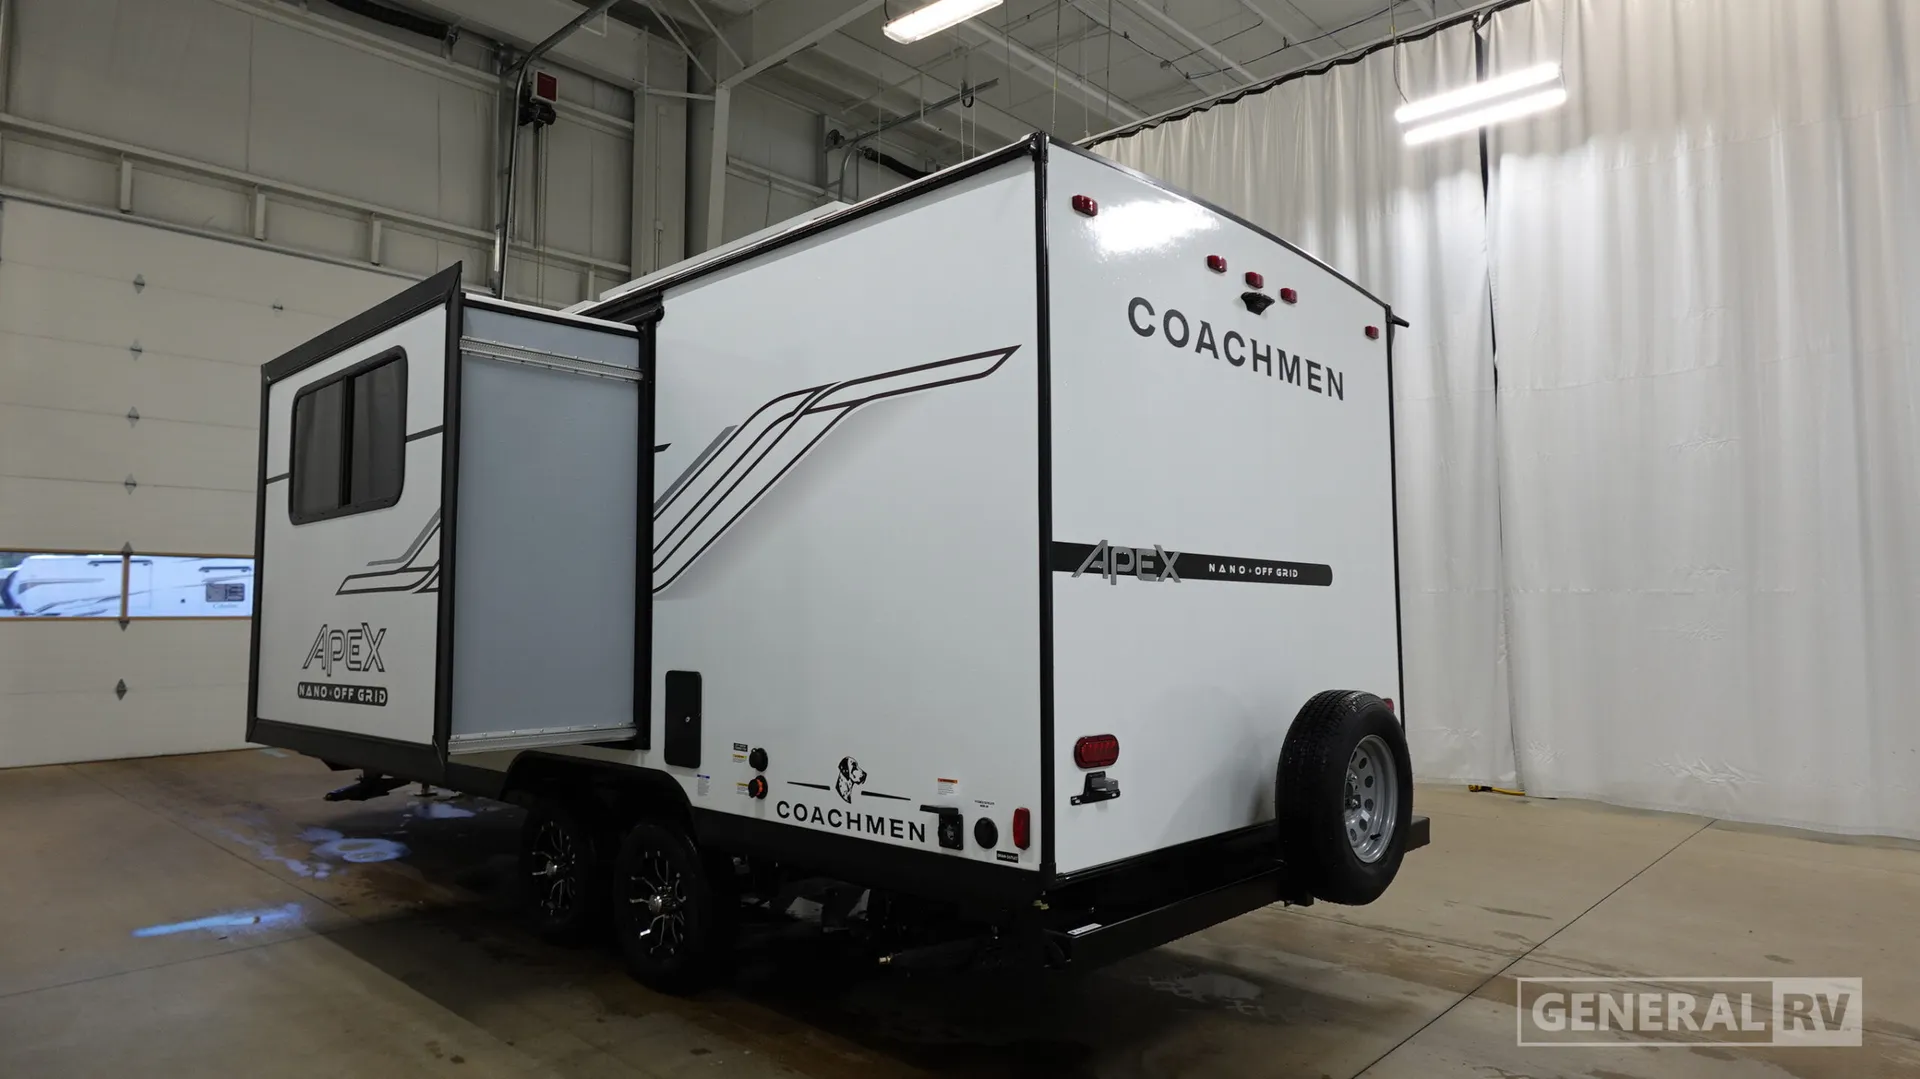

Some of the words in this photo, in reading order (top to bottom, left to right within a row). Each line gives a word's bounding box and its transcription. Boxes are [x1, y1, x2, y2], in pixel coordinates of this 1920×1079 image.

[1128, 297, 1344, 401] COACHMEN
[1071, 539, 1181, 585] APEX
[1208, 563, 1246, 575] NANO
[1254, 566, 1273, 576] OFF
[1276, 568, 1298, 578] GRID
[302, 622, 387, 677] APEX
[299, 684, 328, 698] NANO
[333, 686, 354, 700] OFF
[357, 688, 386, 703] GRID
[776, 800, 925, 843] COACHMEN
